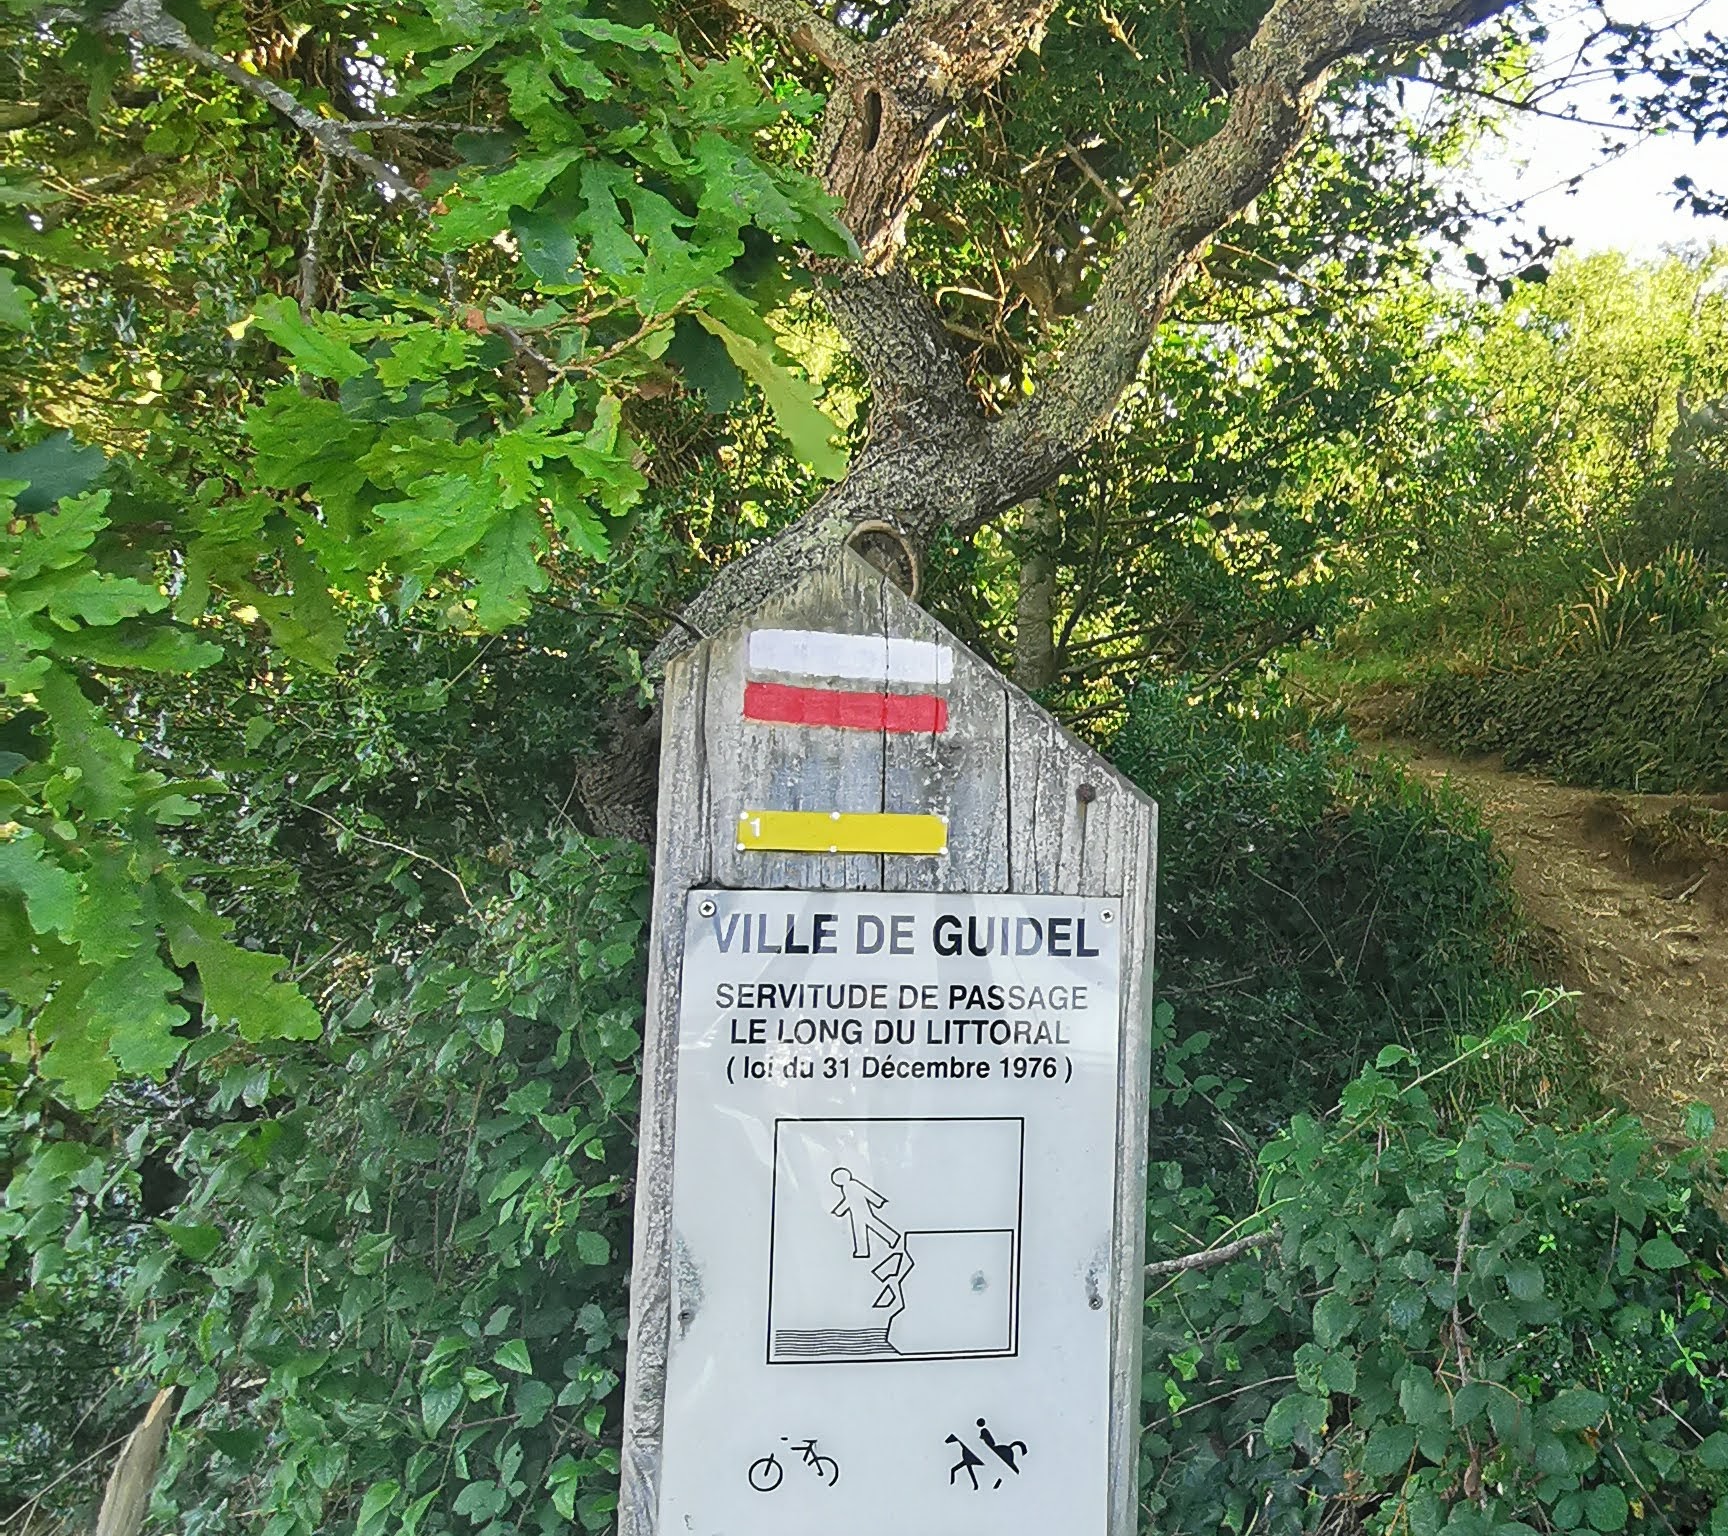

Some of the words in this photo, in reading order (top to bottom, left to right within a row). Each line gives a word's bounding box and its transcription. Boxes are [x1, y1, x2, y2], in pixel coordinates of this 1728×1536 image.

[750, 817, 761, 837] 1
[713, 913, 839, 955] VILLE
[855, 914, 916, 955] DE
[932, 914, 1100, 958] GUIDEL
[715, 983, 888, 1010] SERVITUDE
[898, 984, 939, 1010] DE
[948, 984, 1088, 1011] PASSAGE
[730, 1018, 768, 1045] LE
[777, 1018, 863, 1046] LONG
[874, 1019, 916, 1045] DU
[926, 1019, 1070, 1046] LITTORAL
[782, 1055, 815, 1079] du
[822, 1056, 849, 1079] 31
[862, 1054, 991, 1079] Décembre
[999, 1056, 1057, 1079] 1976
